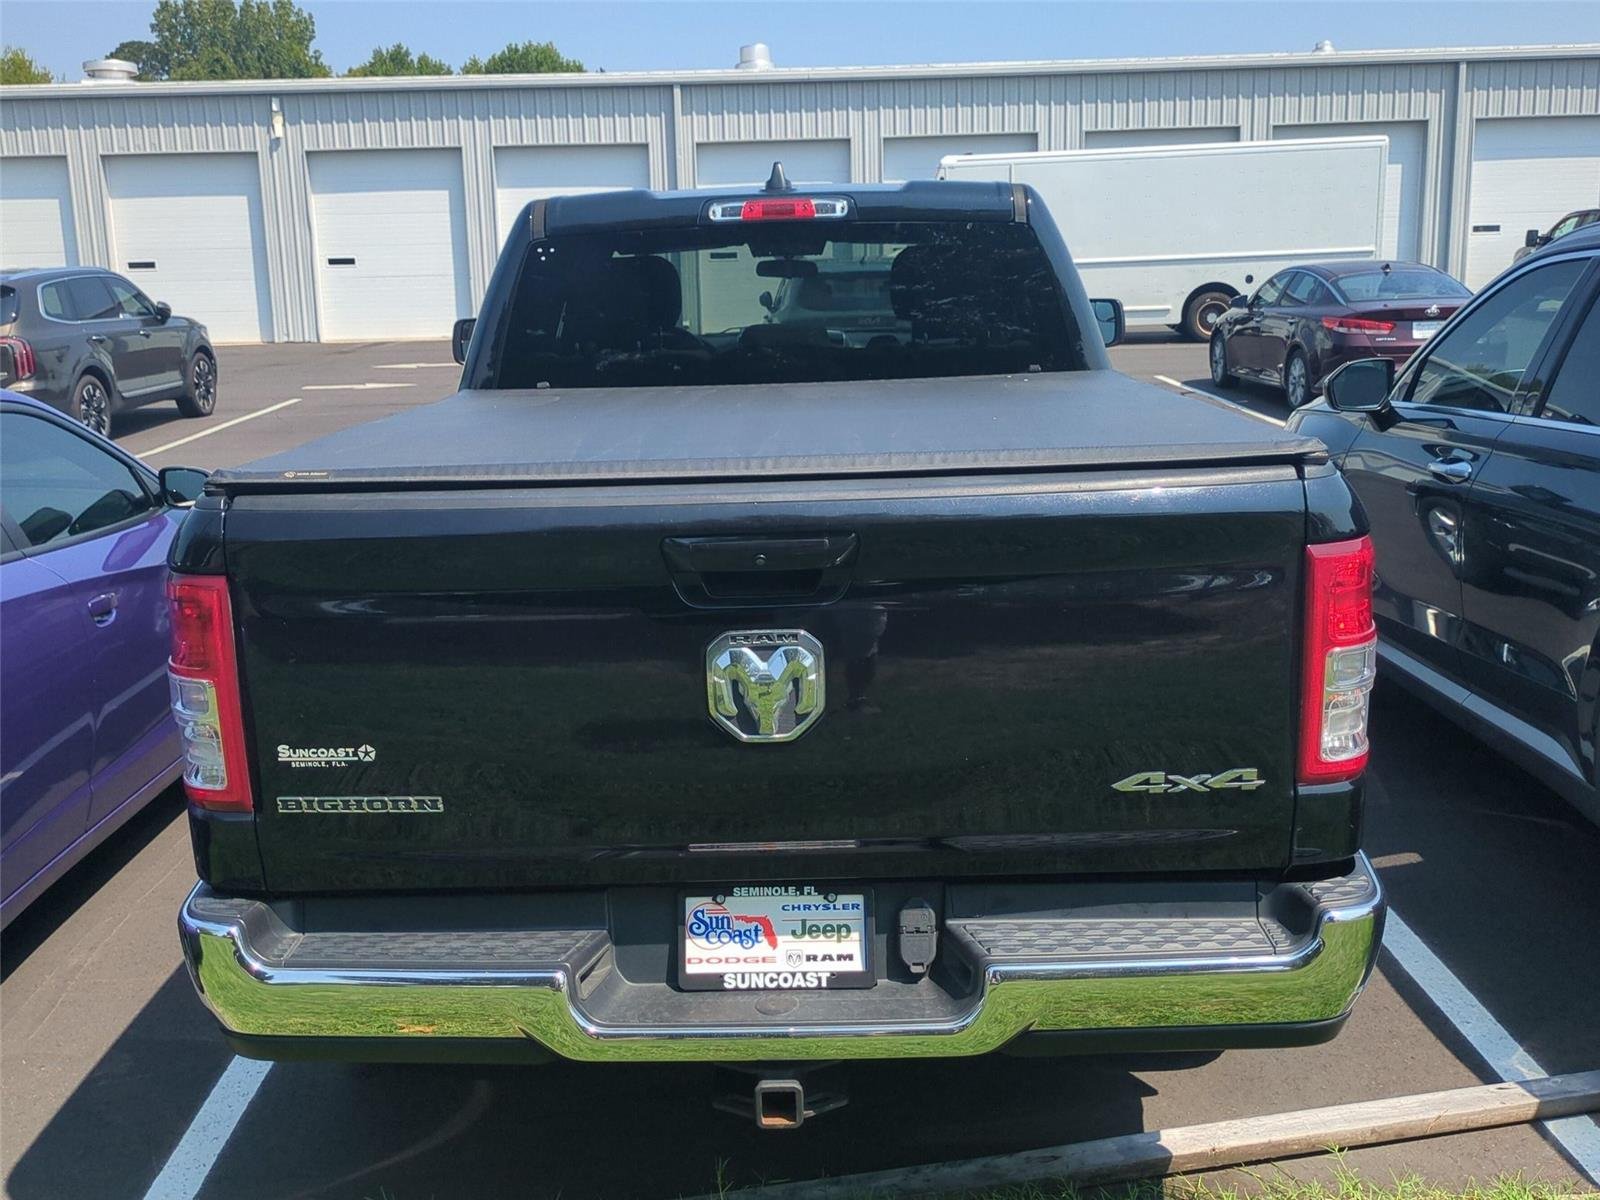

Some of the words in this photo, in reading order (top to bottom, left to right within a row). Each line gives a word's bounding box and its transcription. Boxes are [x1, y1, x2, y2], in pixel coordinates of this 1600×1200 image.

[728, 633, 799, 645] RAM
[277, 744, 355, 758] SUNCOAST
[276, 796, 444, 813] BIGHORN
[733, 886, 800, 897] SEMINOLE,
[803, 886, 819, 896] FL
[781, 903, 861, 912] CHRYSLER
[688, 909, 732, 936] Sun
[791, 919, 852, 943] Jeep
[687, 956, 777, 965] DODGE
[805, 953, 854, 962] RAM
[723, 973, 831, 989] SUNCOAST
